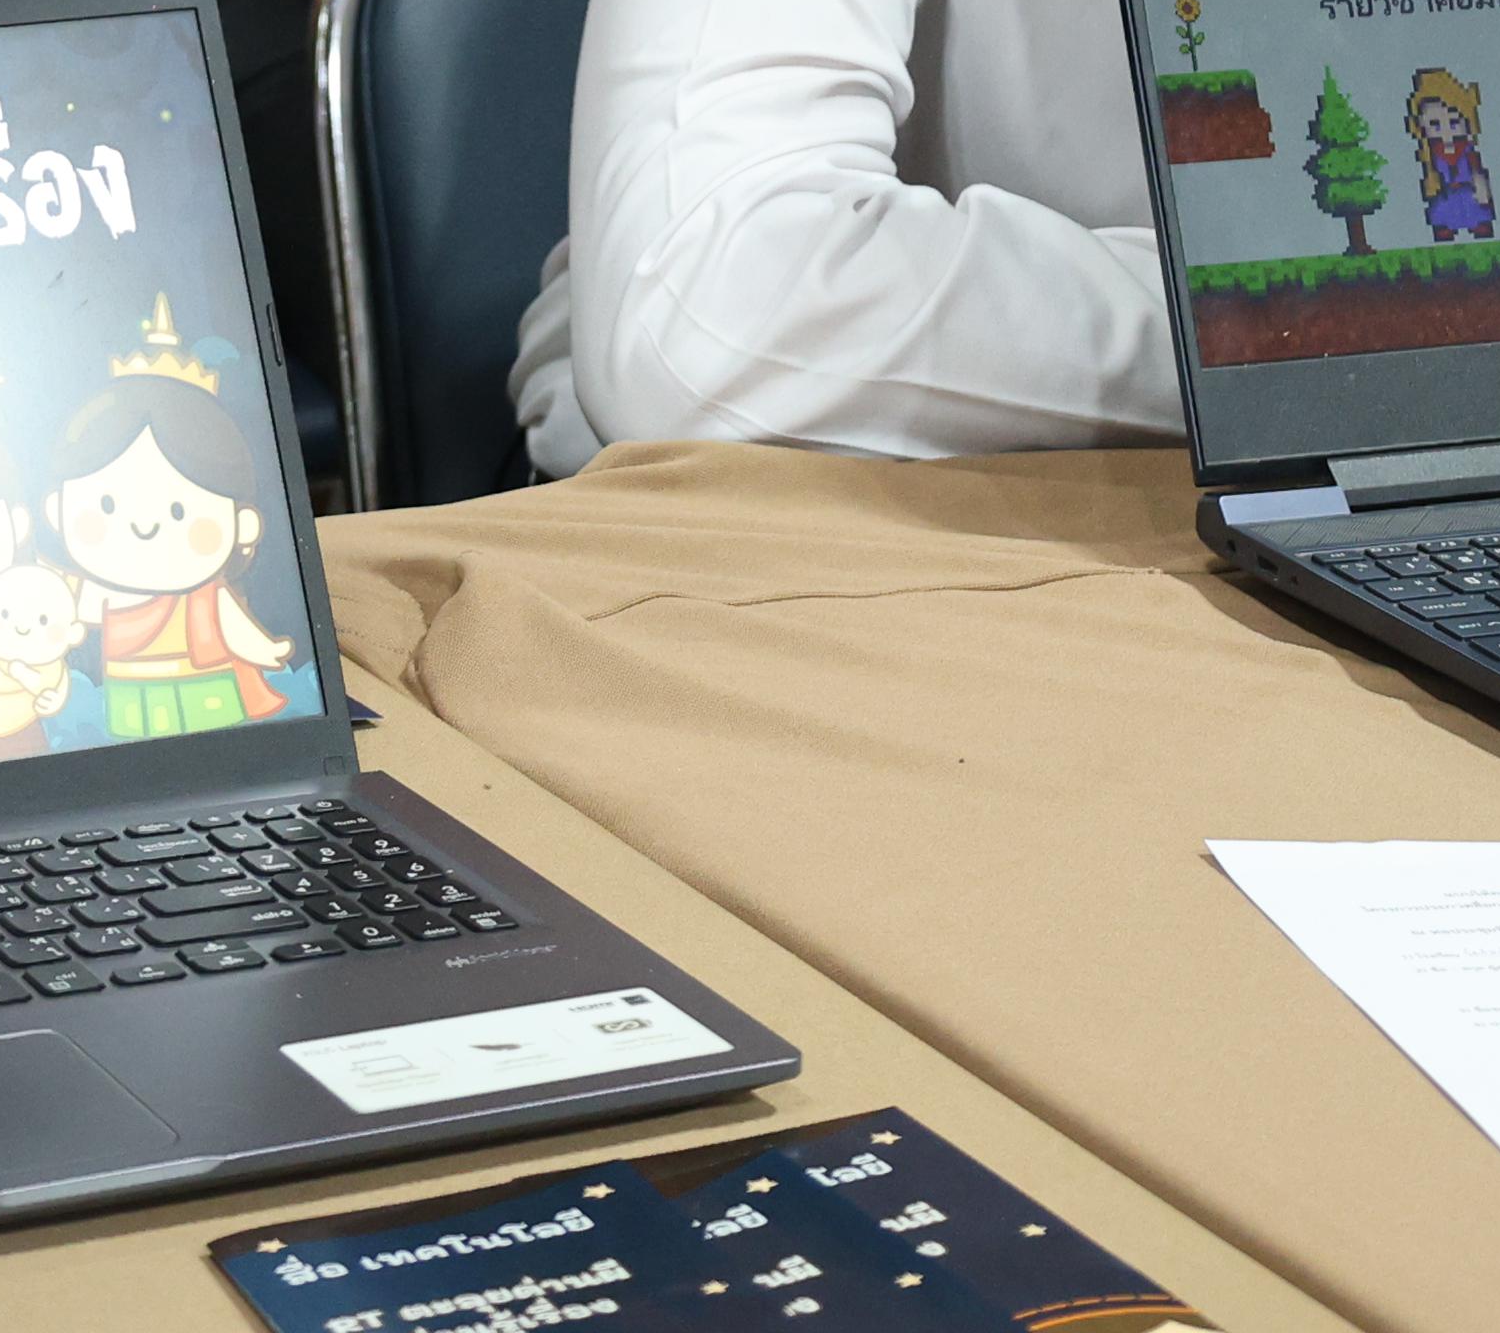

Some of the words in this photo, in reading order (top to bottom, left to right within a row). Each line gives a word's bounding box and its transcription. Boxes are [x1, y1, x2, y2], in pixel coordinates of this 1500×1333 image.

[372, 837, 390, 851] 9
[318, 846, 337, 859] 8
[408, 860, 426, 874] 6
[351, 868, 370, 882] 5
[439, 883, 460, 896] 3
[383, 892, 404, 906] 2
[805, 1152, 894, 1187] โลยี
[359, 1207, 595, 1271] เทคโนโลยี
